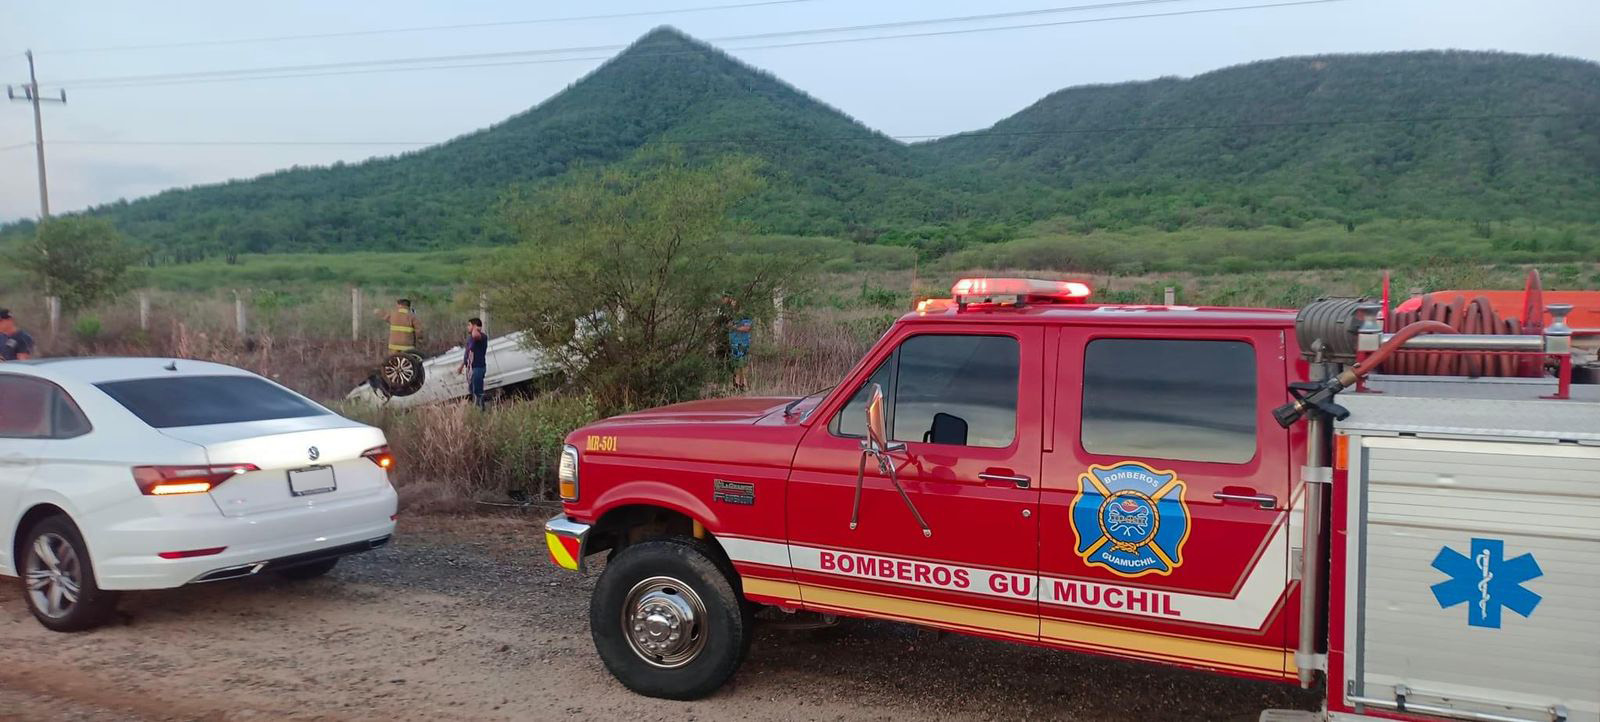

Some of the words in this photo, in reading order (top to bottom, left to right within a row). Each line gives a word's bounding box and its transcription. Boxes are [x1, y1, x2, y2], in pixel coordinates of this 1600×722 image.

[586, 435, 617, 451] MR-501
[1103, 471, 1160, 488] BOMBEROS
[1101, 551, 1157, 567] GUAMUCHIL
[820, 551, 970, 588] BOMBEROS
